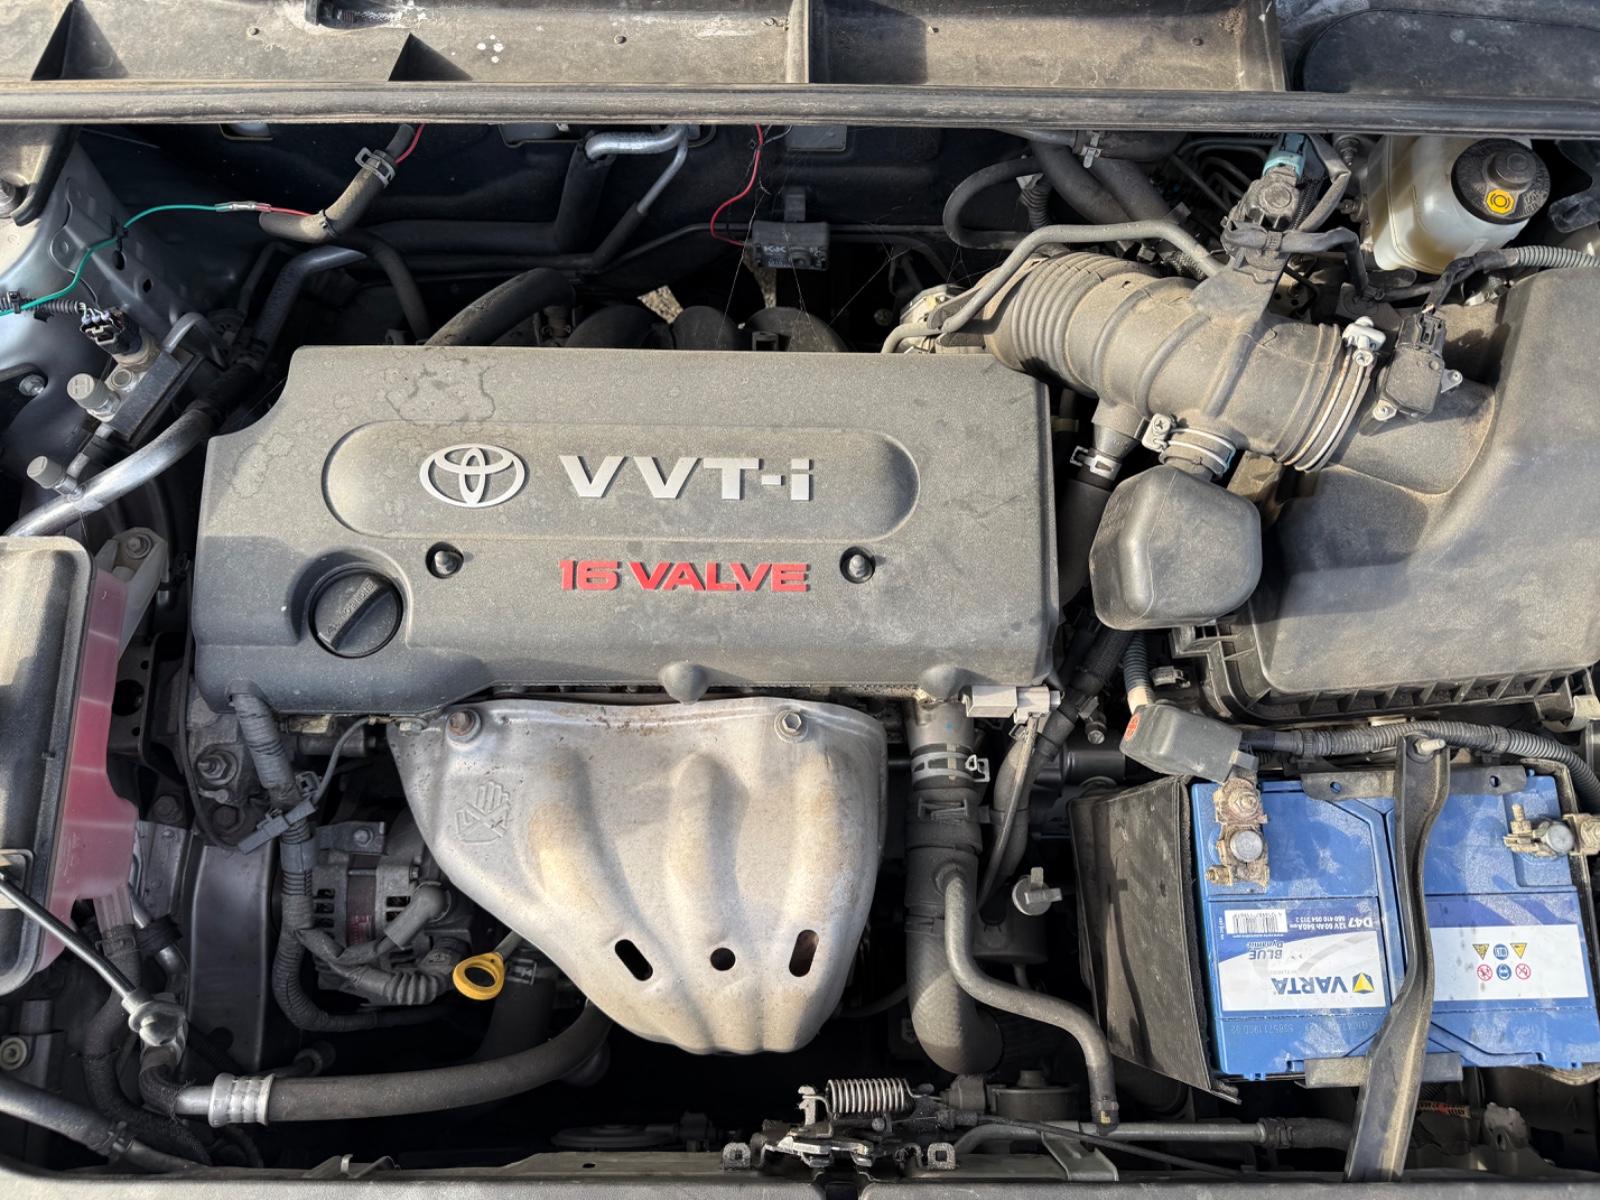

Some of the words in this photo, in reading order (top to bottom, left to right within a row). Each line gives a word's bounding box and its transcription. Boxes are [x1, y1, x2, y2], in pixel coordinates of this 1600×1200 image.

[558, 455, 811, 501] VVT-i
[559, 559, 621, 591] 16
[627, 559, 809, 592] VALVE
[1348, 916, 1373, 929] D47
[1248, 949, 1283, 960] BLUE
[1271, 976, 1348, 995] VARTA
